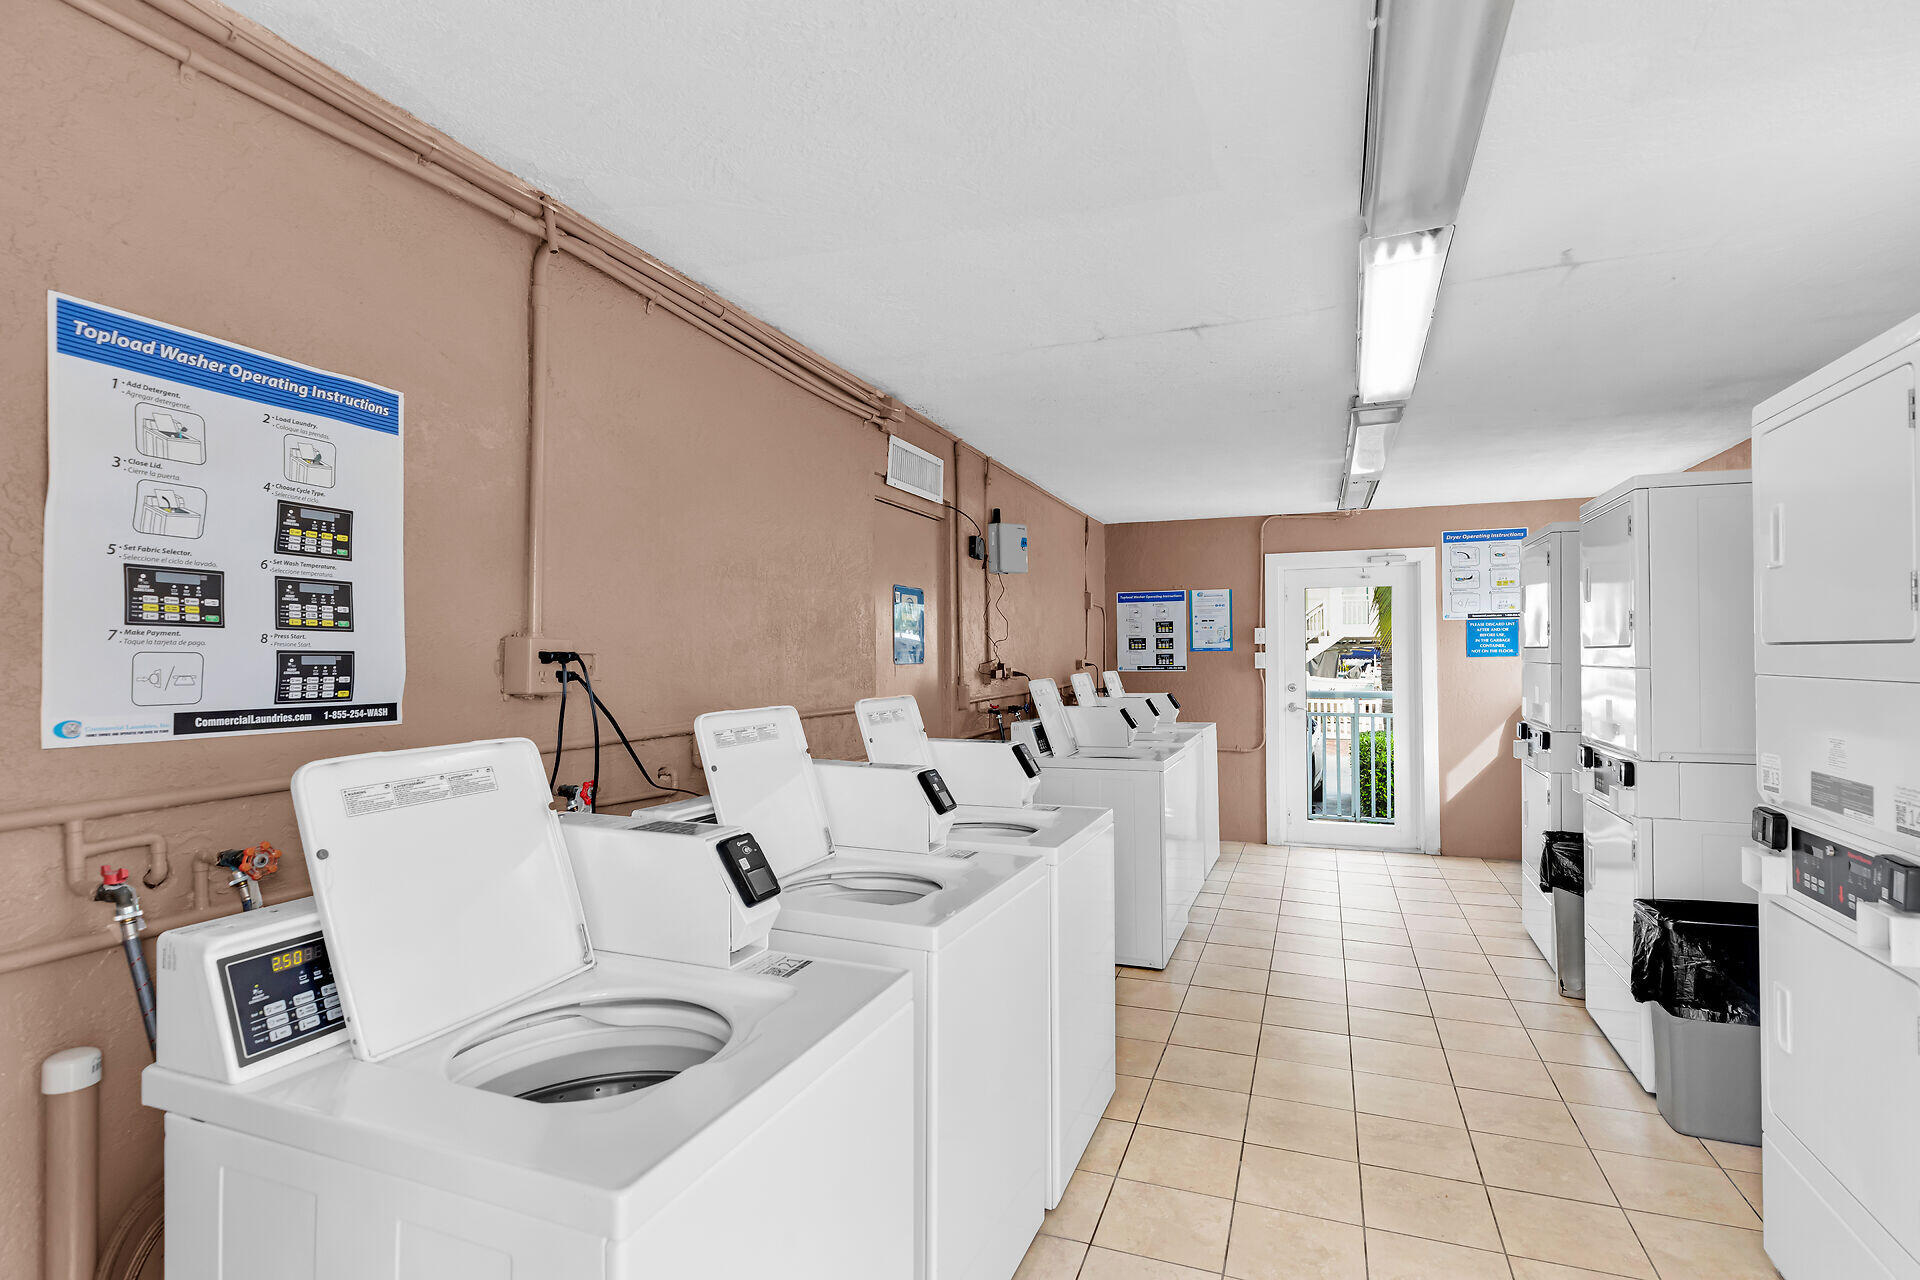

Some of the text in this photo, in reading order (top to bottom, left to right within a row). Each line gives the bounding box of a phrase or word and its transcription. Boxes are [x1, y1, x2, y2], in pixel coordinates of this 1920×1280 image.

[73, 319, 389, 416] Topload Washer Operating Instructions
[125, 390, 153, 401] Agregar
[126, 381, 141, 389] Add
[143, 384, 181, 399] Detergent.
[262, 413, 270, 424] 2
[111, 456, 163, 470] 3 Close Lid.
[128, 467, 148, 476] Cierre
[263, 482, 271, 492] 4
[275, 483, 296, 492] Choose
[296, 487, 310, 496] Cycle
[106, 543, 116, 555] 5
[137, 545, 161, 554] Fabric
[162, 547, 192, 557] Selector.
[123, 553, 160, 563] Seleccione
[168, 558, 184, 566] ciclo
[260, 559, 268, 570] 6
[300, 562, 337, 571] Temperature.
[107, 629, 118, 641] 7
[146, 630, 182, 638] Payment.
[260, 633, 268, 644] 8
[154, 639, 177, 647] tarjeta
[195, 707, 389, 728] CommercialLaundries.com 1-855-254-WASH
[271, 950, 303, 972] 2.50
